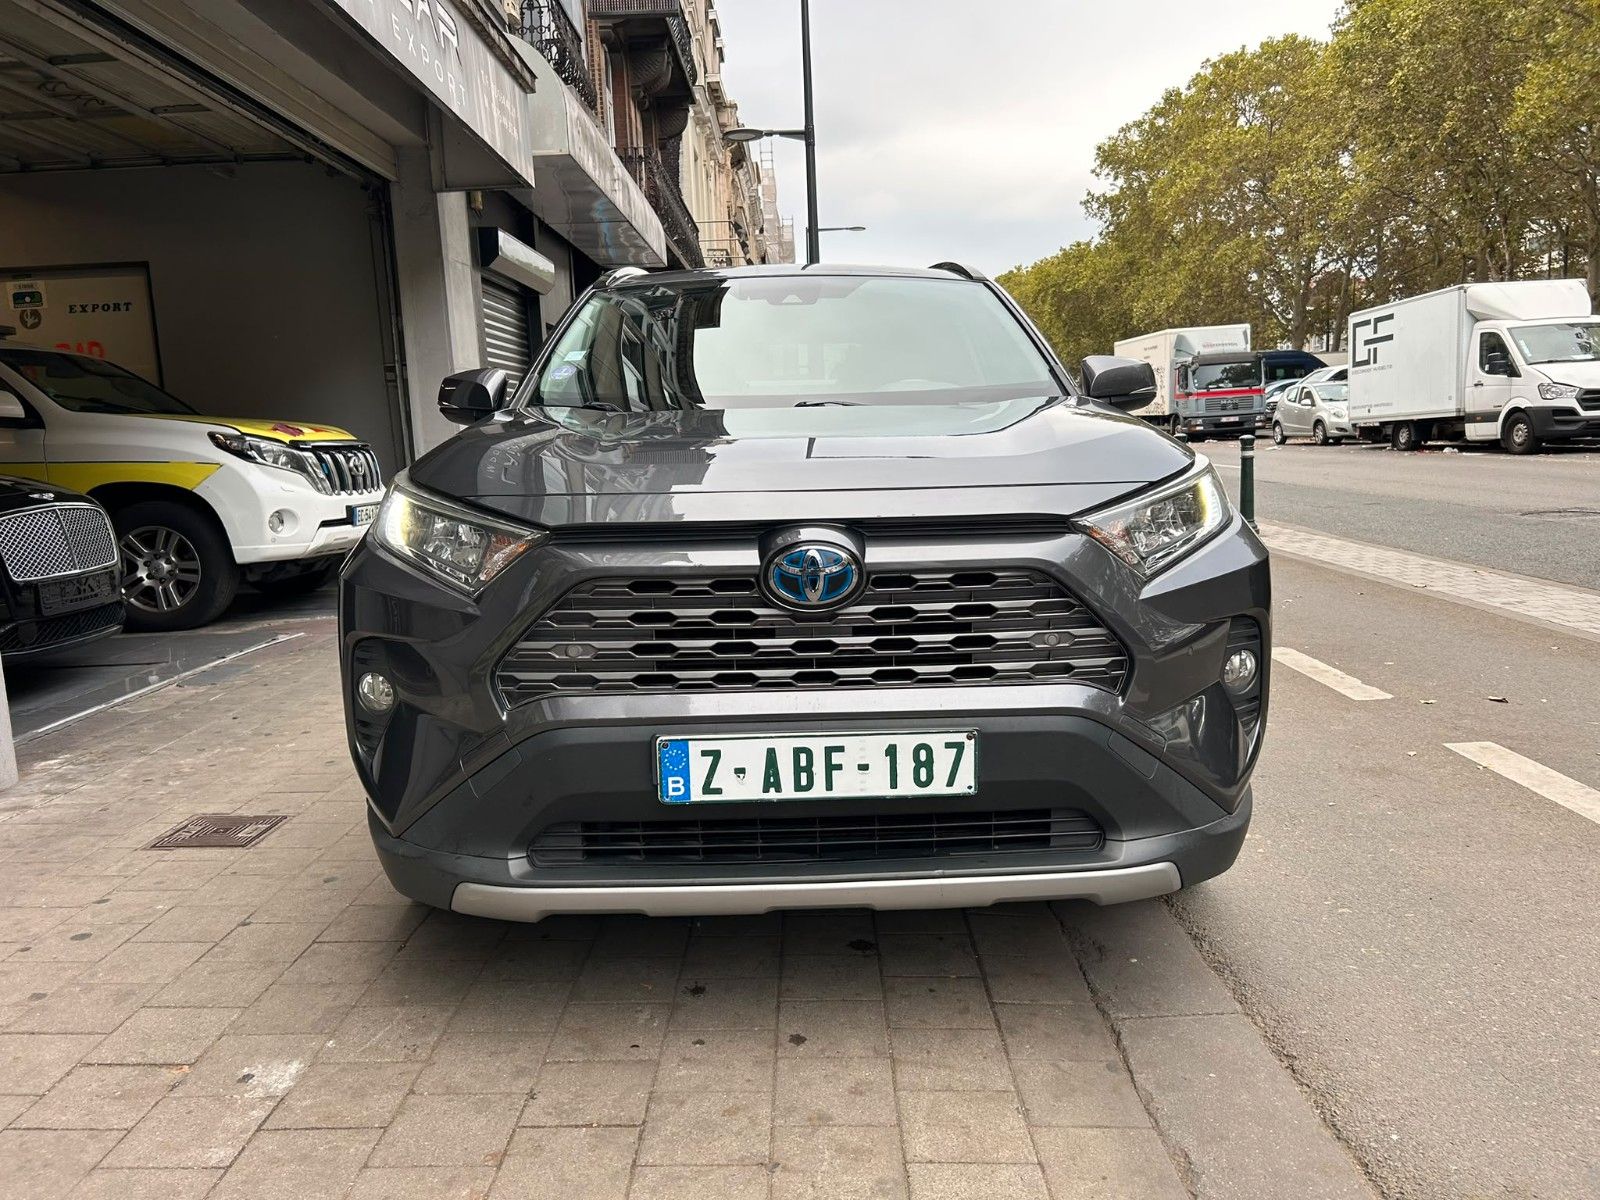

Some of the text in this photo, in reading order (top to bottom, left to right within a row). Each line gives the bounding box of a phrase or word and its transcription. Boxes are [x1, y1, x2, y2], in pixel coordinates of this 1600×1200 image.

[399, 0, 462, 62] AR
[391, 13, 466, 107] EXPORT
[68, 302, 133, 314] EXPORT
[667, 777, 685, 796] B
[700, 741, 965, 795] Z-ABF-187
